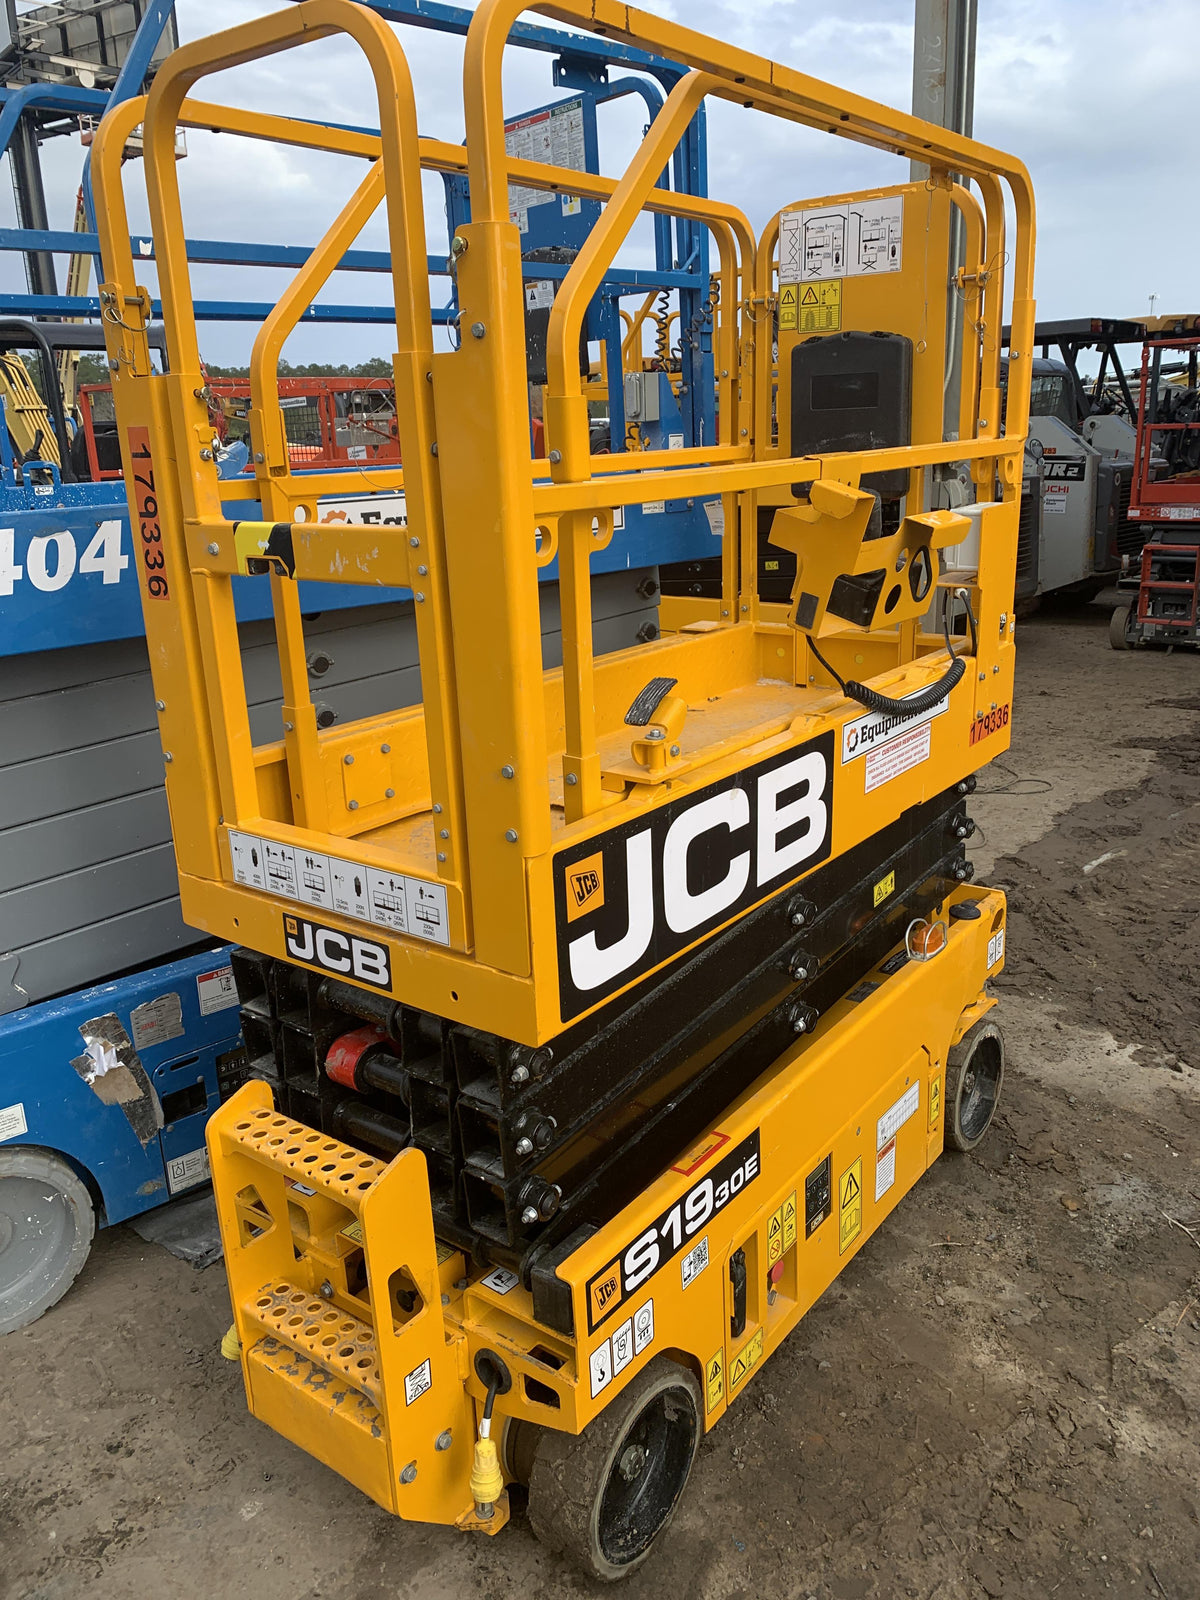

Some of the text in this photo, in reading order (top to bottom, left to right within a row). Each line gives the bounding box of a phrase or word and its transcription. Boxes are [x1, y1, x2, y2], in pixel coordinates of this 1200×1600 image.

[131, 443, 168, 597] 179336
[969, 704, 1009, 741] 179336
[568, 750, 827, 991] JCB
[575, 871, 598, 900] JCB
[287, 923, 389, 985] JCB
[599, 1278, 617, 1307] JCB
